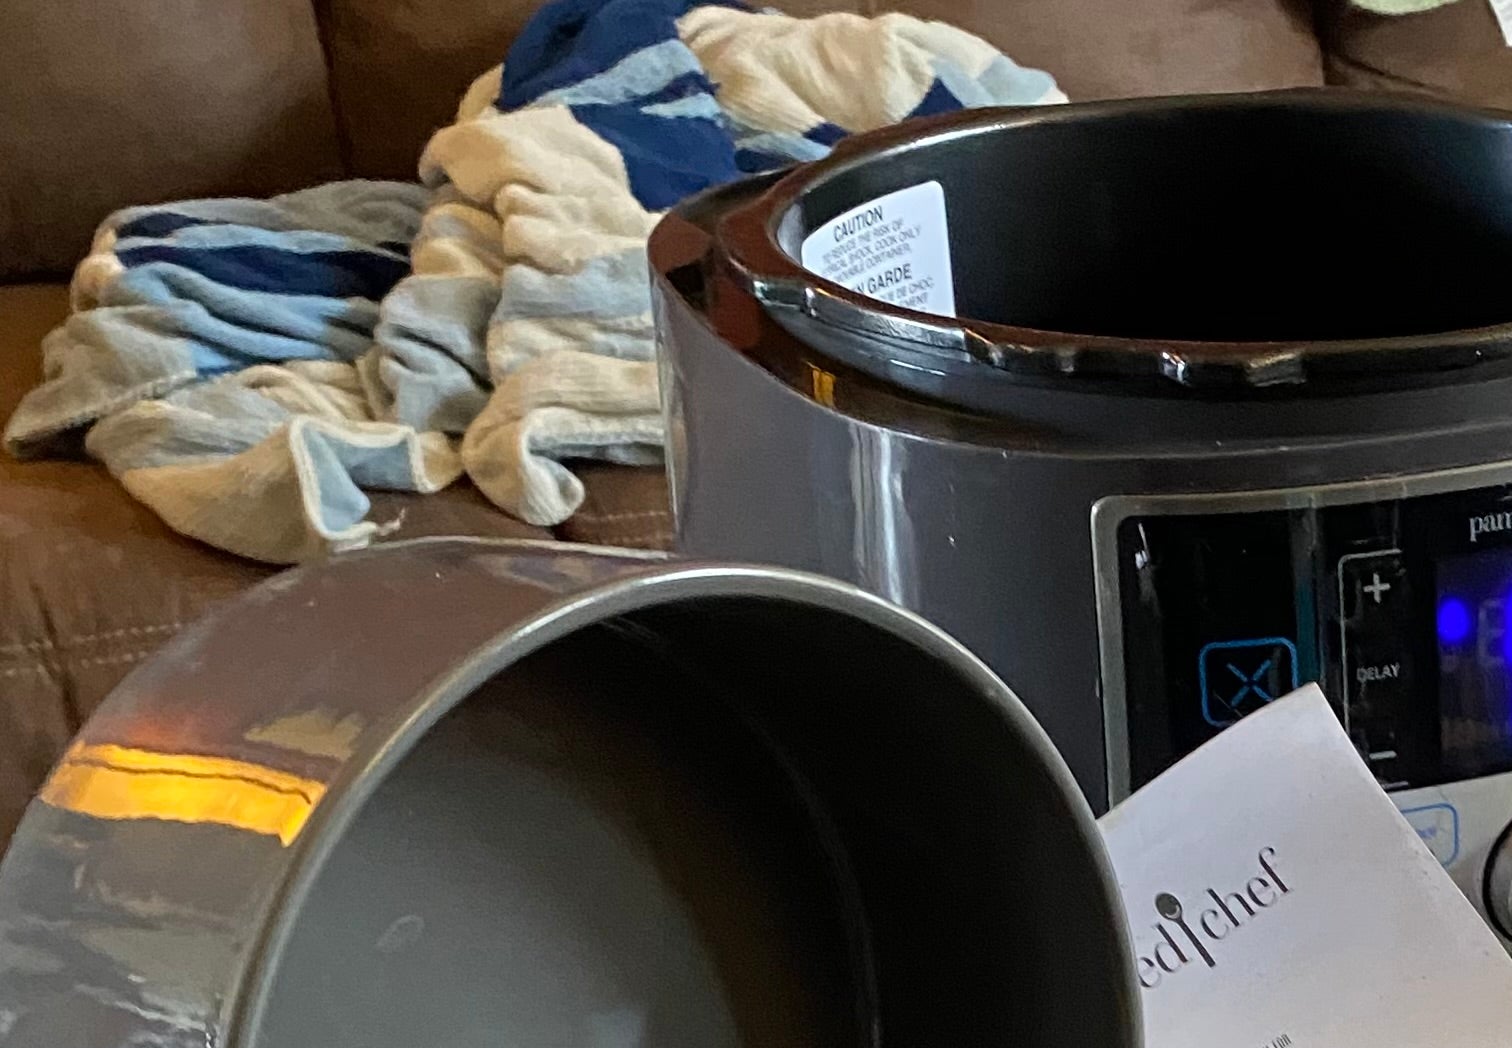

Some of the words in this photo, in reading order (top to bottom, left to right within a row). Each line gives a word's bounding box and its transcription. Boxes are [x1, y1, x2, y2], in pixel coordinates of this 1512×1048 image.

[833, 205, 884, 242] CAUTION
[868, 263, 914, 294] GARDE
[1357, 661, 1400, 682] DELAY
[1200, 846, 1294, 940] chef
